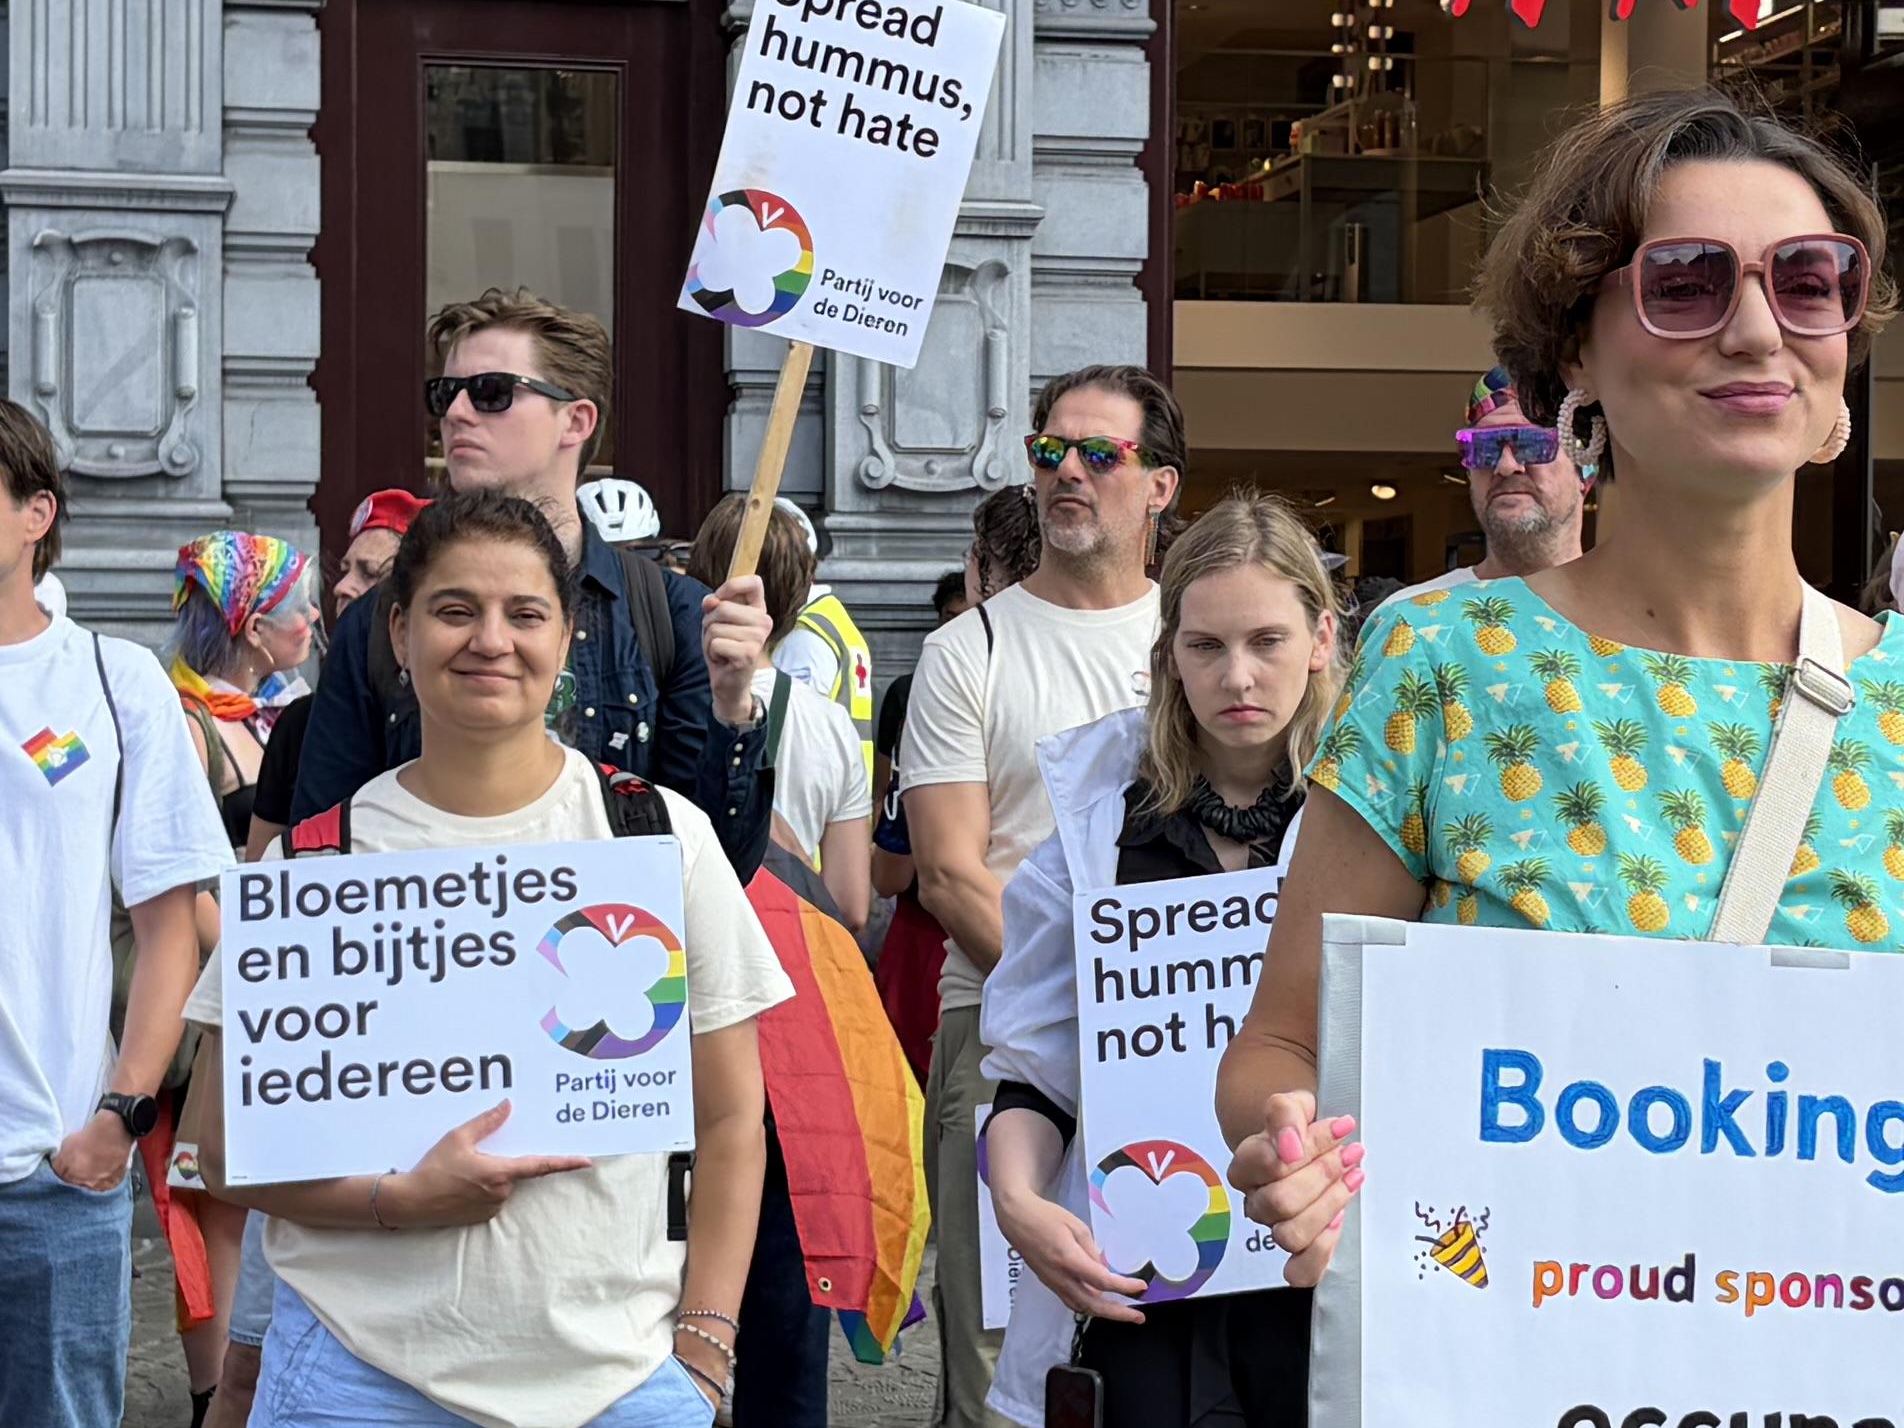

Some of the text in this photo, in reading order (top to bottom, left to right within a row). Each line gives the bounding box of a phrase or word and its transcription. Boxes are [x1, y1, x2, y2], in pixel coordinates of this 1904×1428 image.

[760, 14, 972, 121] hummus,
[747, 81, 938, 157] not hate
[821, 269, 923, 310] Partij voor
[814, 298, 907, 336] de Dieren
[240, 855, 577, 921] Bloemetjes
[238, 919, 516, 986] en bijtjes
[1094, 951, 1264, 1004] humm
[238, 1001, 377, 1043] voor
[1098, 1012, 1186, 1062] not
[241, 1050, 512, 1106] iedereen
[556, 1069, 676, 1094] Partij voor
[556, 1100, 669, 1123] de Dieren
[1532, 1254, 1696, 1310] proud
